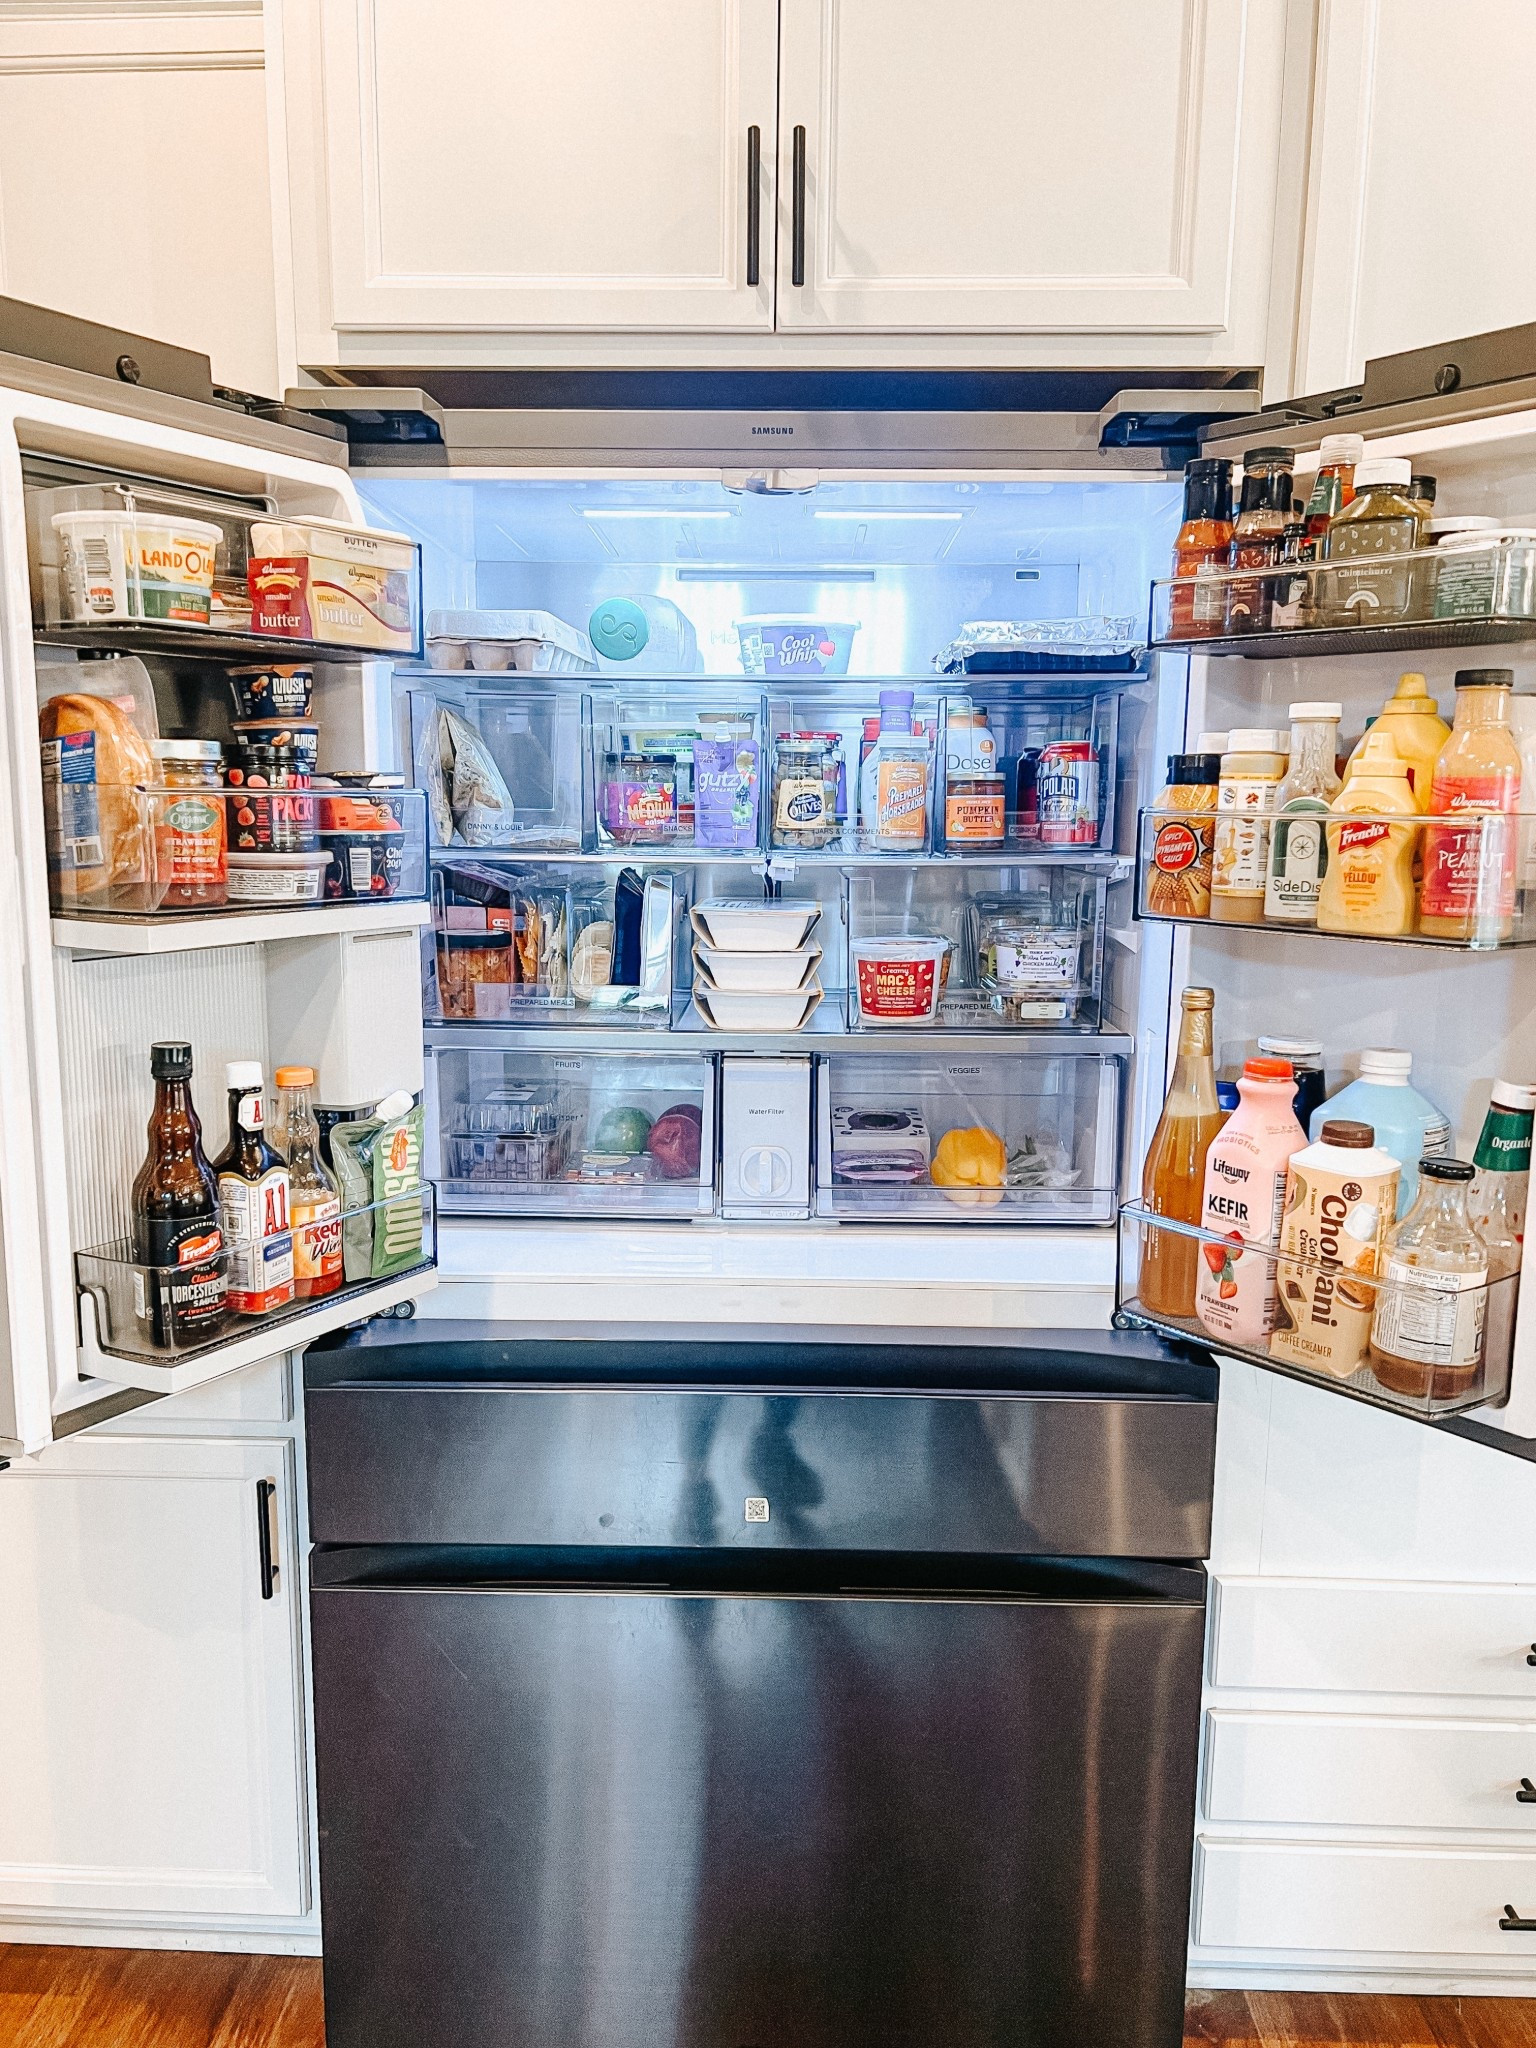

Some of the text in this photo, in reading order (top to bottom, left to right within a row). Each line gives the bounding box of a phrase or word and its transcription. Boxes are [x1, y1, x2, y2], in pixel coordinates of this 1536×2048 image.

[752, 427, 794, 435] SAMSUNG
[141, 549, 183, 568] LAND
[185, 551, 202, 574] O
[1338, 567, 1392, 577] Chimichurri
[265, 593, 292, 601] unsalted
[317, 594, 346, 604] unsalted
[260, 612, 301, 627] butter
[318, 602, 364, 626] butter
[781, 634, 815, 651] Cool
[777, 645, 820, 667] Whip
[272, 677, 305, 694] MUSH
[947, 754, 991, 770] Dose
[699, 771, 750, 792] gutzy
[1043, 776, 1077, 798] POLAR
[888, 783, 924, 805] PREPARED
[1451, 792, 1500, 808] Wegmans
[378, 808, 389, 817] 25
[627, 801, 676, 821] MEDIUM
[789, 800, 822, 819] OLIVES
[957, 806, 1000, 815] PUMPKIN
[170, 812, 211, 829] Organic
[644, 818, 666, 826] salsa
[963, 815, 994, 823] BUTTER
[500, 823, 523, 831] LOUIE
[1164, 831, 1184, 841] SPICY
[1341, 824, 1388, 846] French's
[1156, 841, 1194, 855] DYNAMITE
[1162, 854, 1184, 863] SAUCE
[1343, 872, 1377, 884] YELLOW
[1272, 879, 1321, 893] SideDis
[880, 965, 910, 976] Creamy
[876, 974, 916, 986] MAC &
[876, 986, 916, 996] CHEESE
[511, 998, 549, 1006] PREPARED
[940, 1003, 1005, 1011] PREPARED MEALS
[555, 1061, 581, 1069] FRUITS
[948, 1066, 980, 1074] VEGGIES
[1217, 1136, 1260, 1155] PROBIOTICS
[1491, 1136, 1532, 1152] Organic
[1213, 1157, 1251, 1183] Lifeway
[1208, 1193, 1249, 1221] KEFIR
[182, 1236, 219, 1262] French's
[1311, 1194, 1348, 1328] Chobani
[191, 1271, 219, 1284] Classic
[1408, 1269, 1459, 1283] Nutrition Facts
[193, 1294, 219, 1307] SAUCE
[1200, 1293, 1239, 1313] STRAWBERRY
[1278, 1330, 1332, 1358] COFFEE CREAMER
